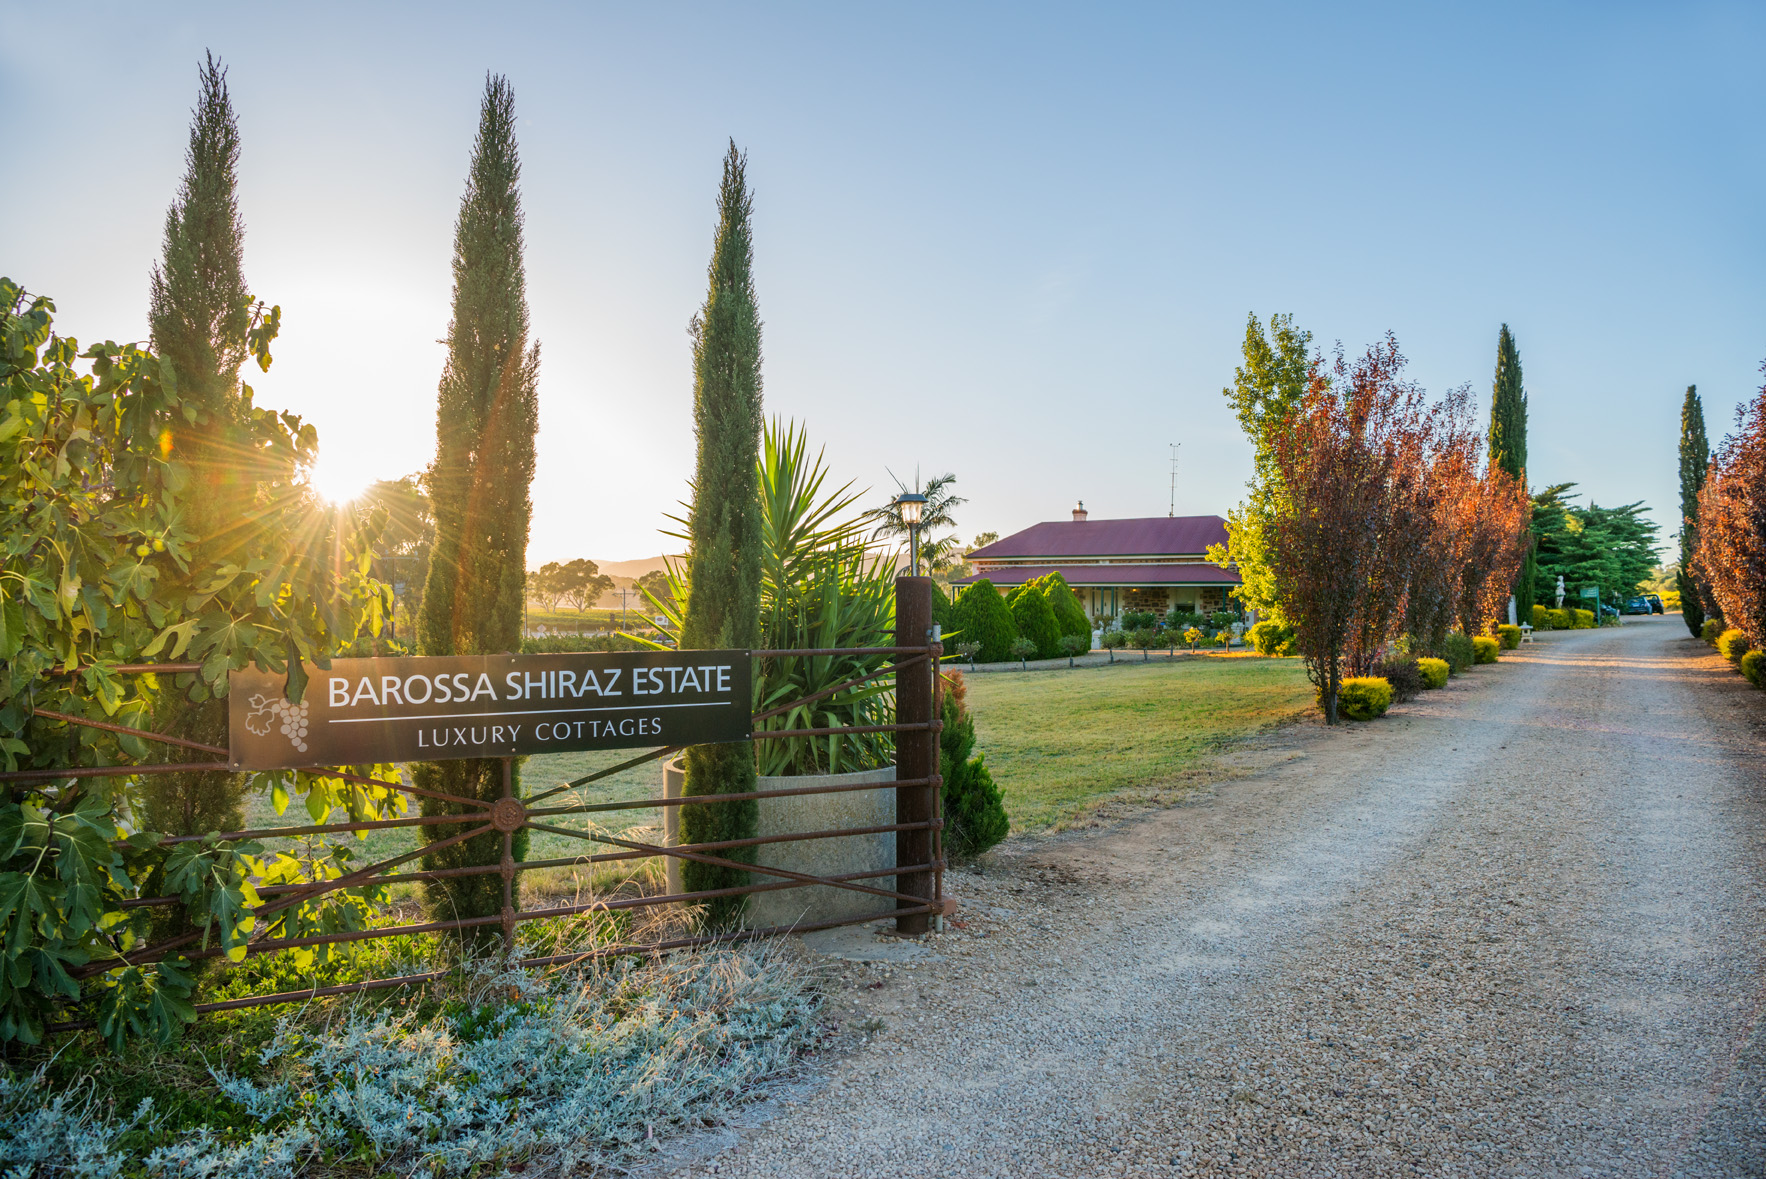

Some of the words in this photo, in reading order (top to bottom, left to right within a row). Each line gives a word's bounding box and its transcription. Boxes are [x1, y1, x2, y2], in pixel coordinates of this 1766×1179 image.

[329, 672, 498, 707] BAROSSA
[506, 669, 622, 700] SHIRAZ
[632, 665, 731, 694] ESTATE
[418, 725, 521, 748] LUXURY
[535, 717, 662, 741] COTTAGES
